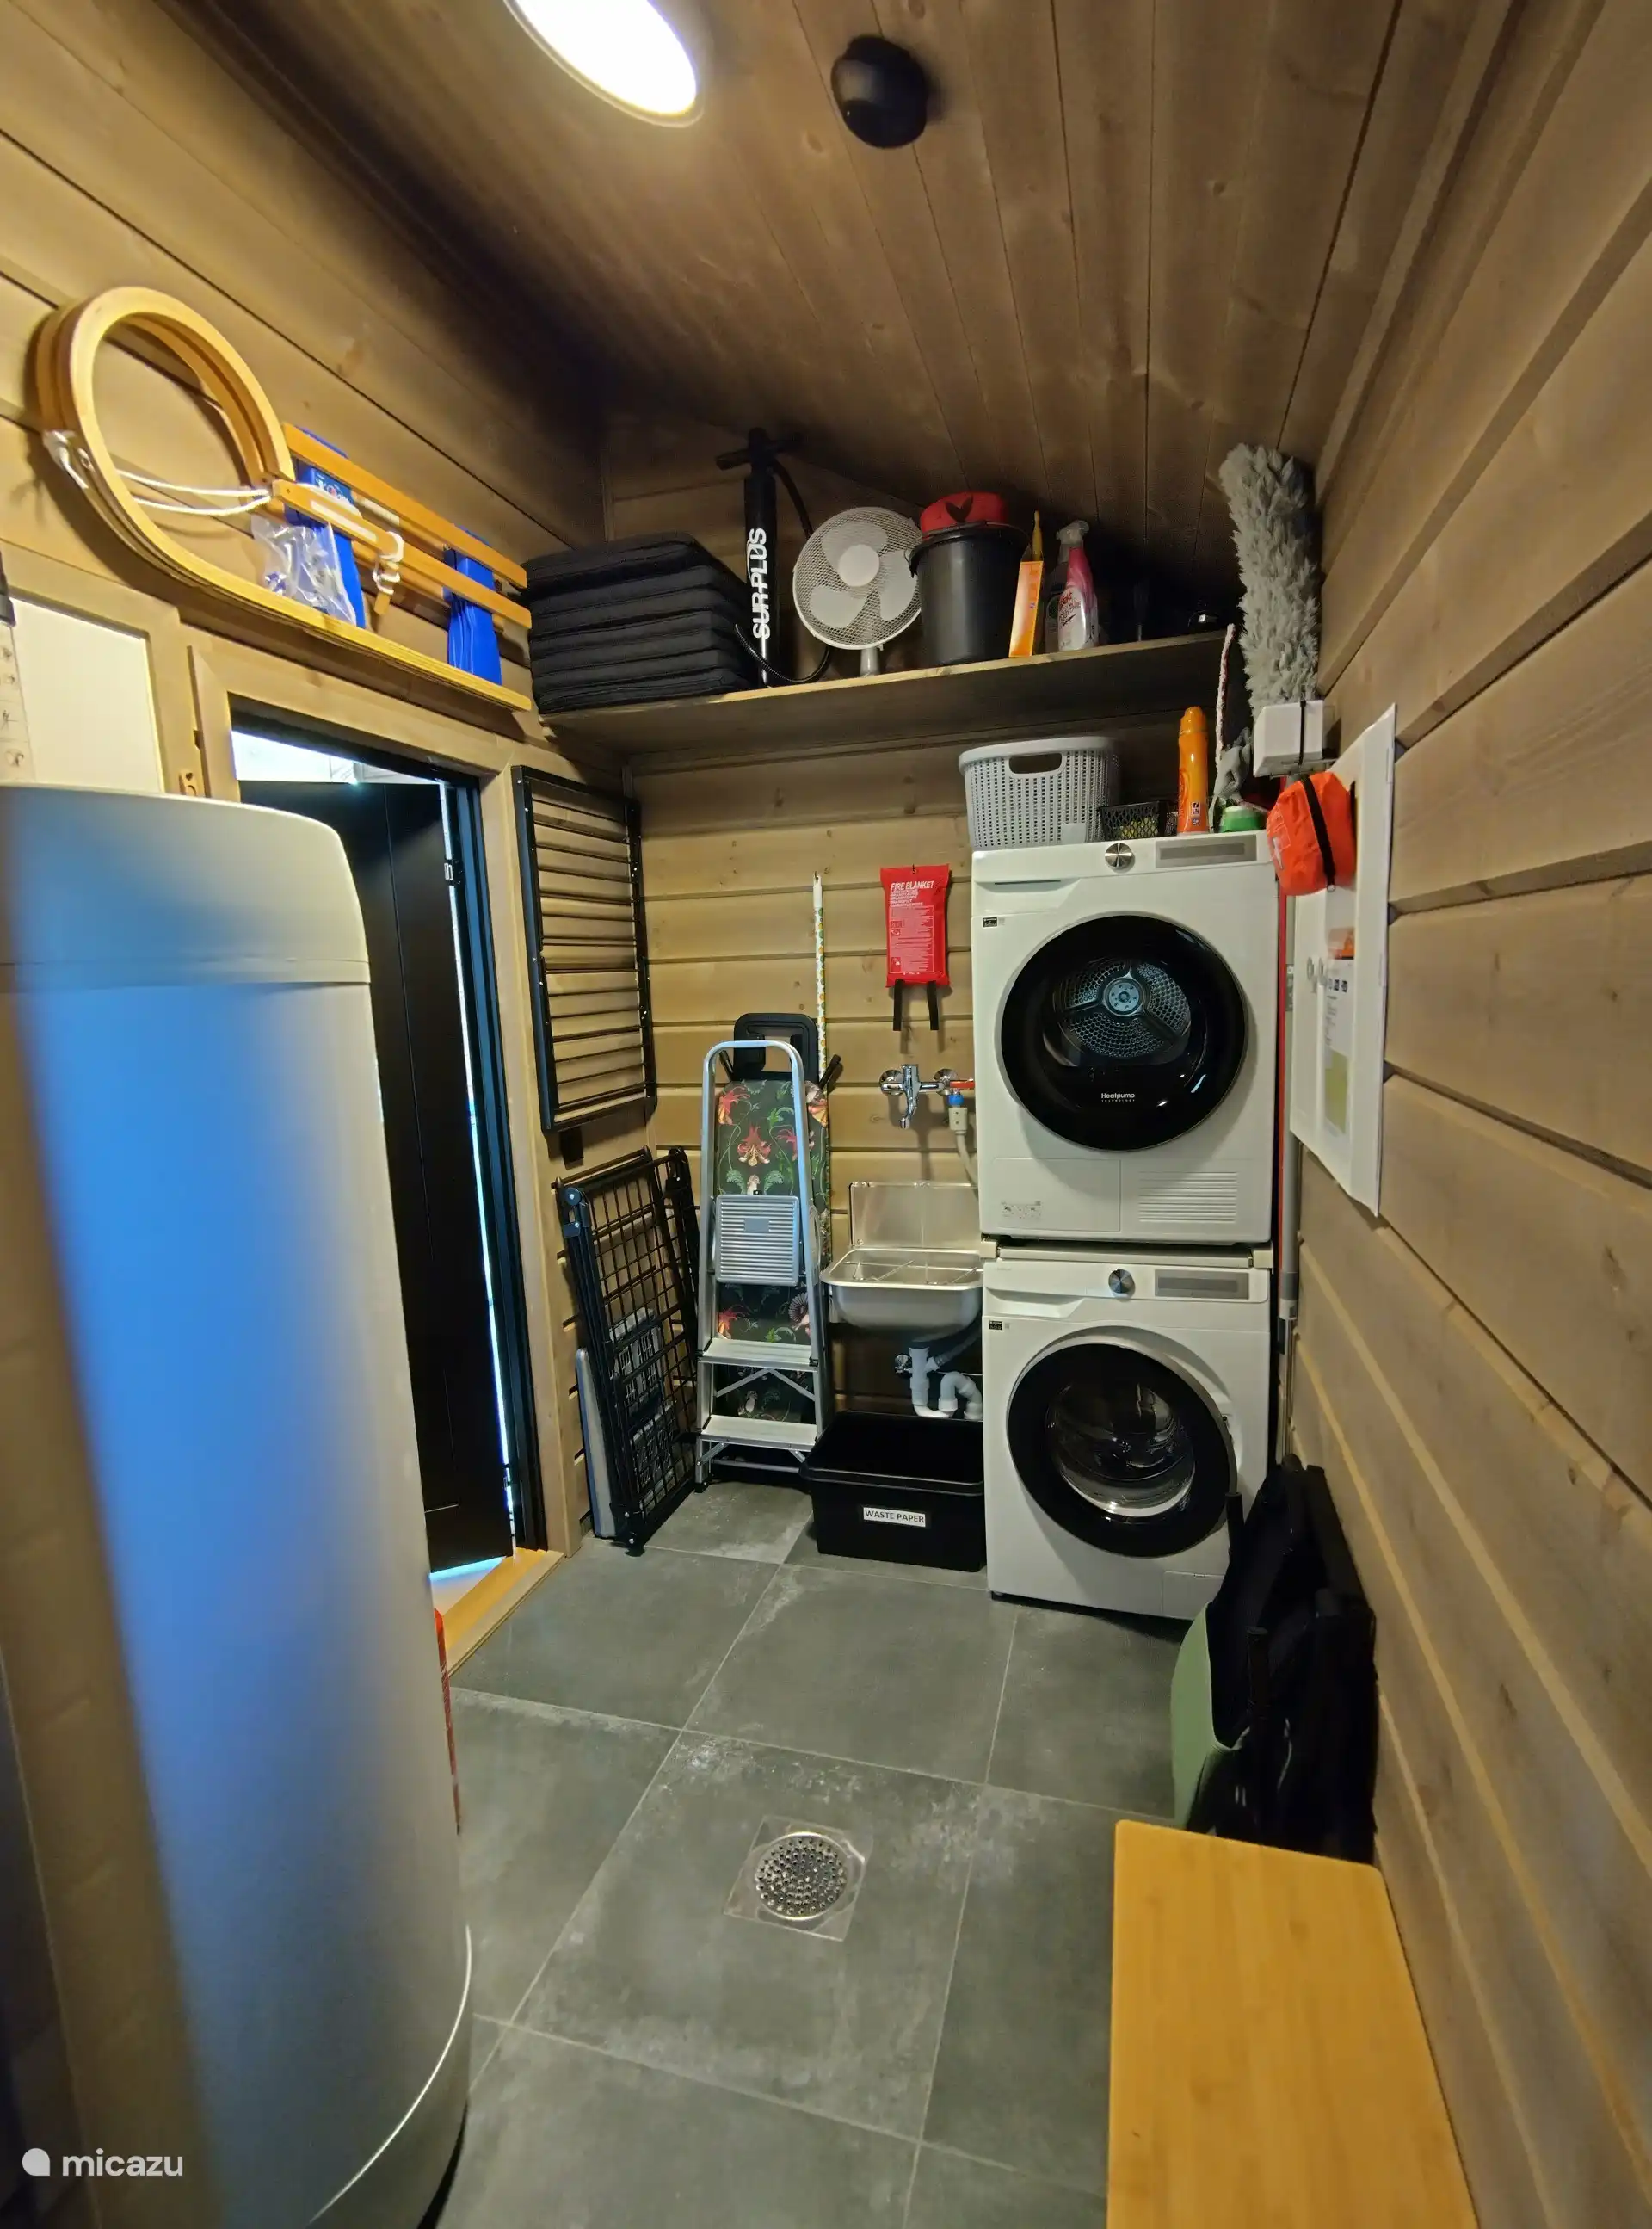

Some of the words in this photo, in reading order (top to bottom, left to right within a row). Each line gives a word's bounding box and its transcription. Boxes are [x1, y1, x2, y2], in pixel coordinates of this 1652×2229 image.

[747, 528, 770, 639] SURPLUS
[891, 882, 905, 891] FIRE
[905, 880, 934, 890] BLANKET
[865, 1510, 894, 1519] WASTE
[897, 1513, 924, 1522] PAPER
